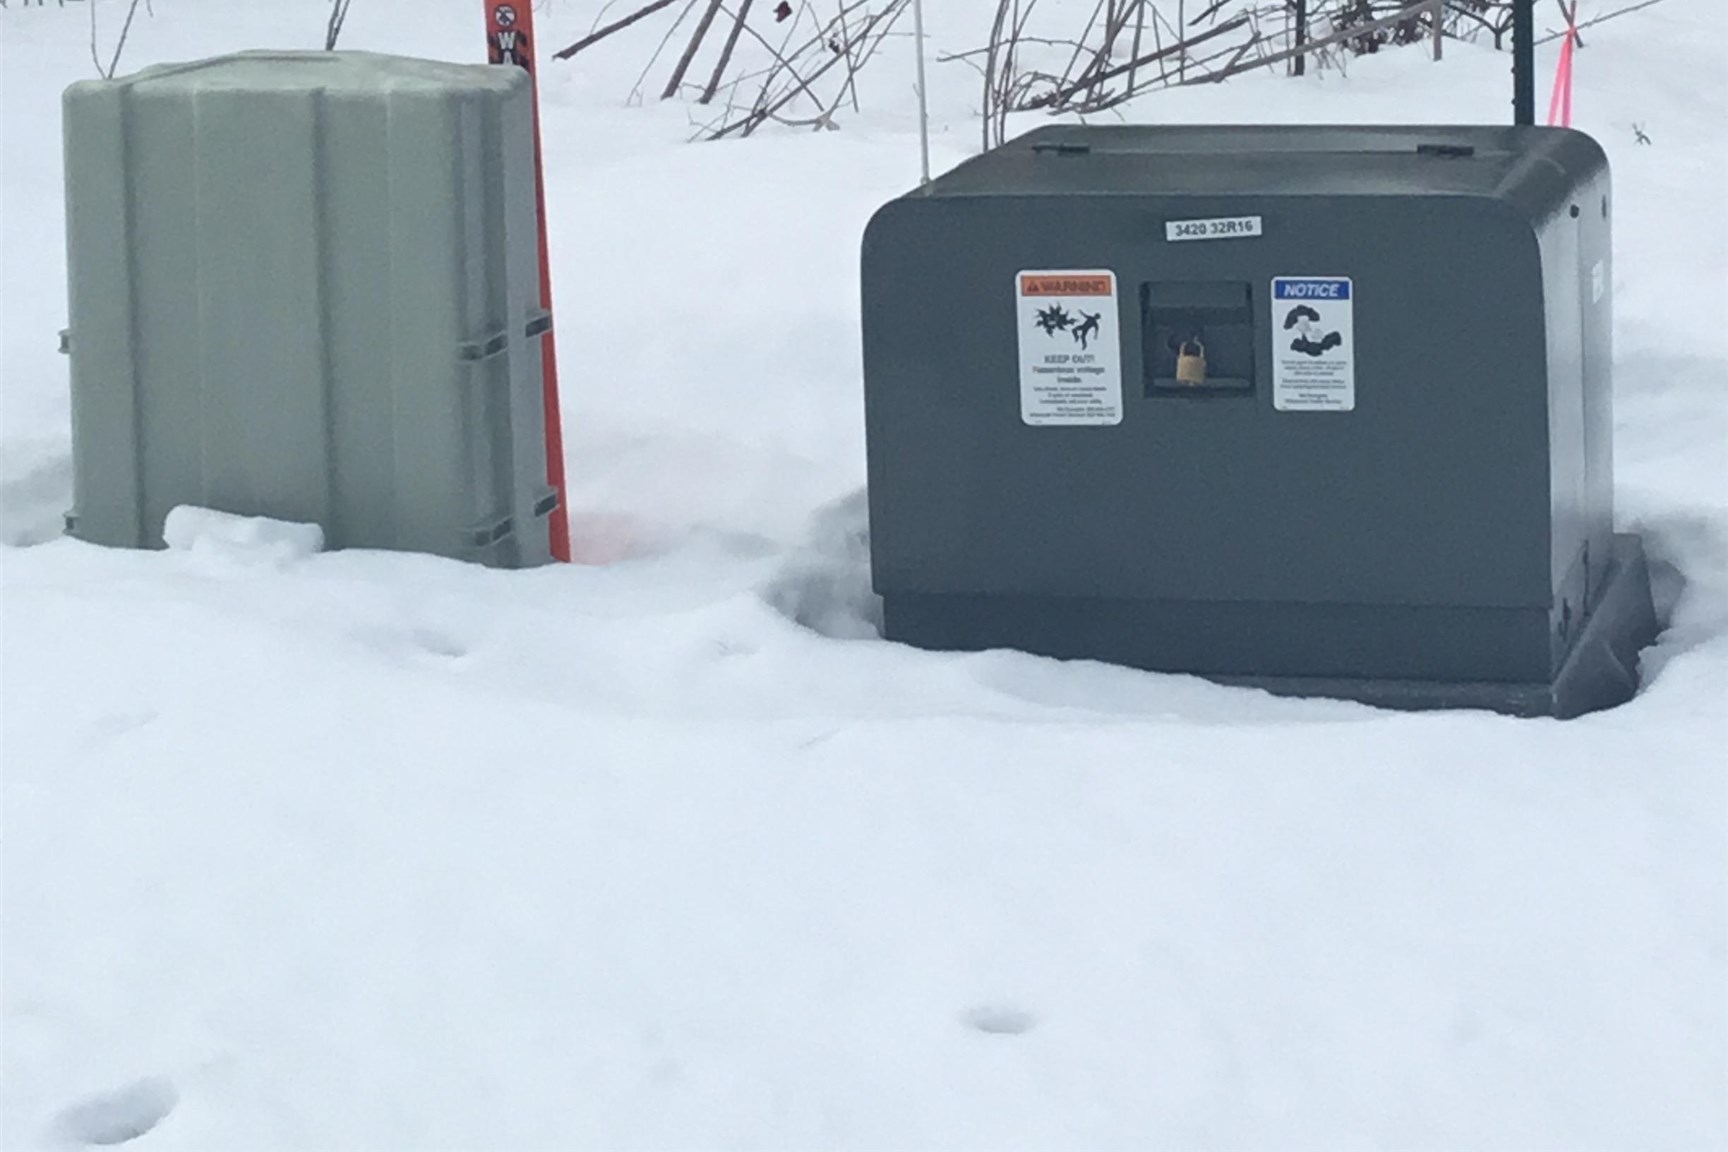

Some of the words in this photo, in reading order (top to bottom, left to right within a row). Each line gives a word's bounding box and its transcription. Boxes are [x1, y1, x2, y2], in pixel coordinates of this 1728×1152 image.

[1175, 222, 1207, 237] 3420
[1209, 219, 1254, 234] 32R16
[1041, 280, 1106, 293] WARNING
[1283, 283, 1341, 298] NOTICE
[1044, 354, 1070, 364] KEEP
